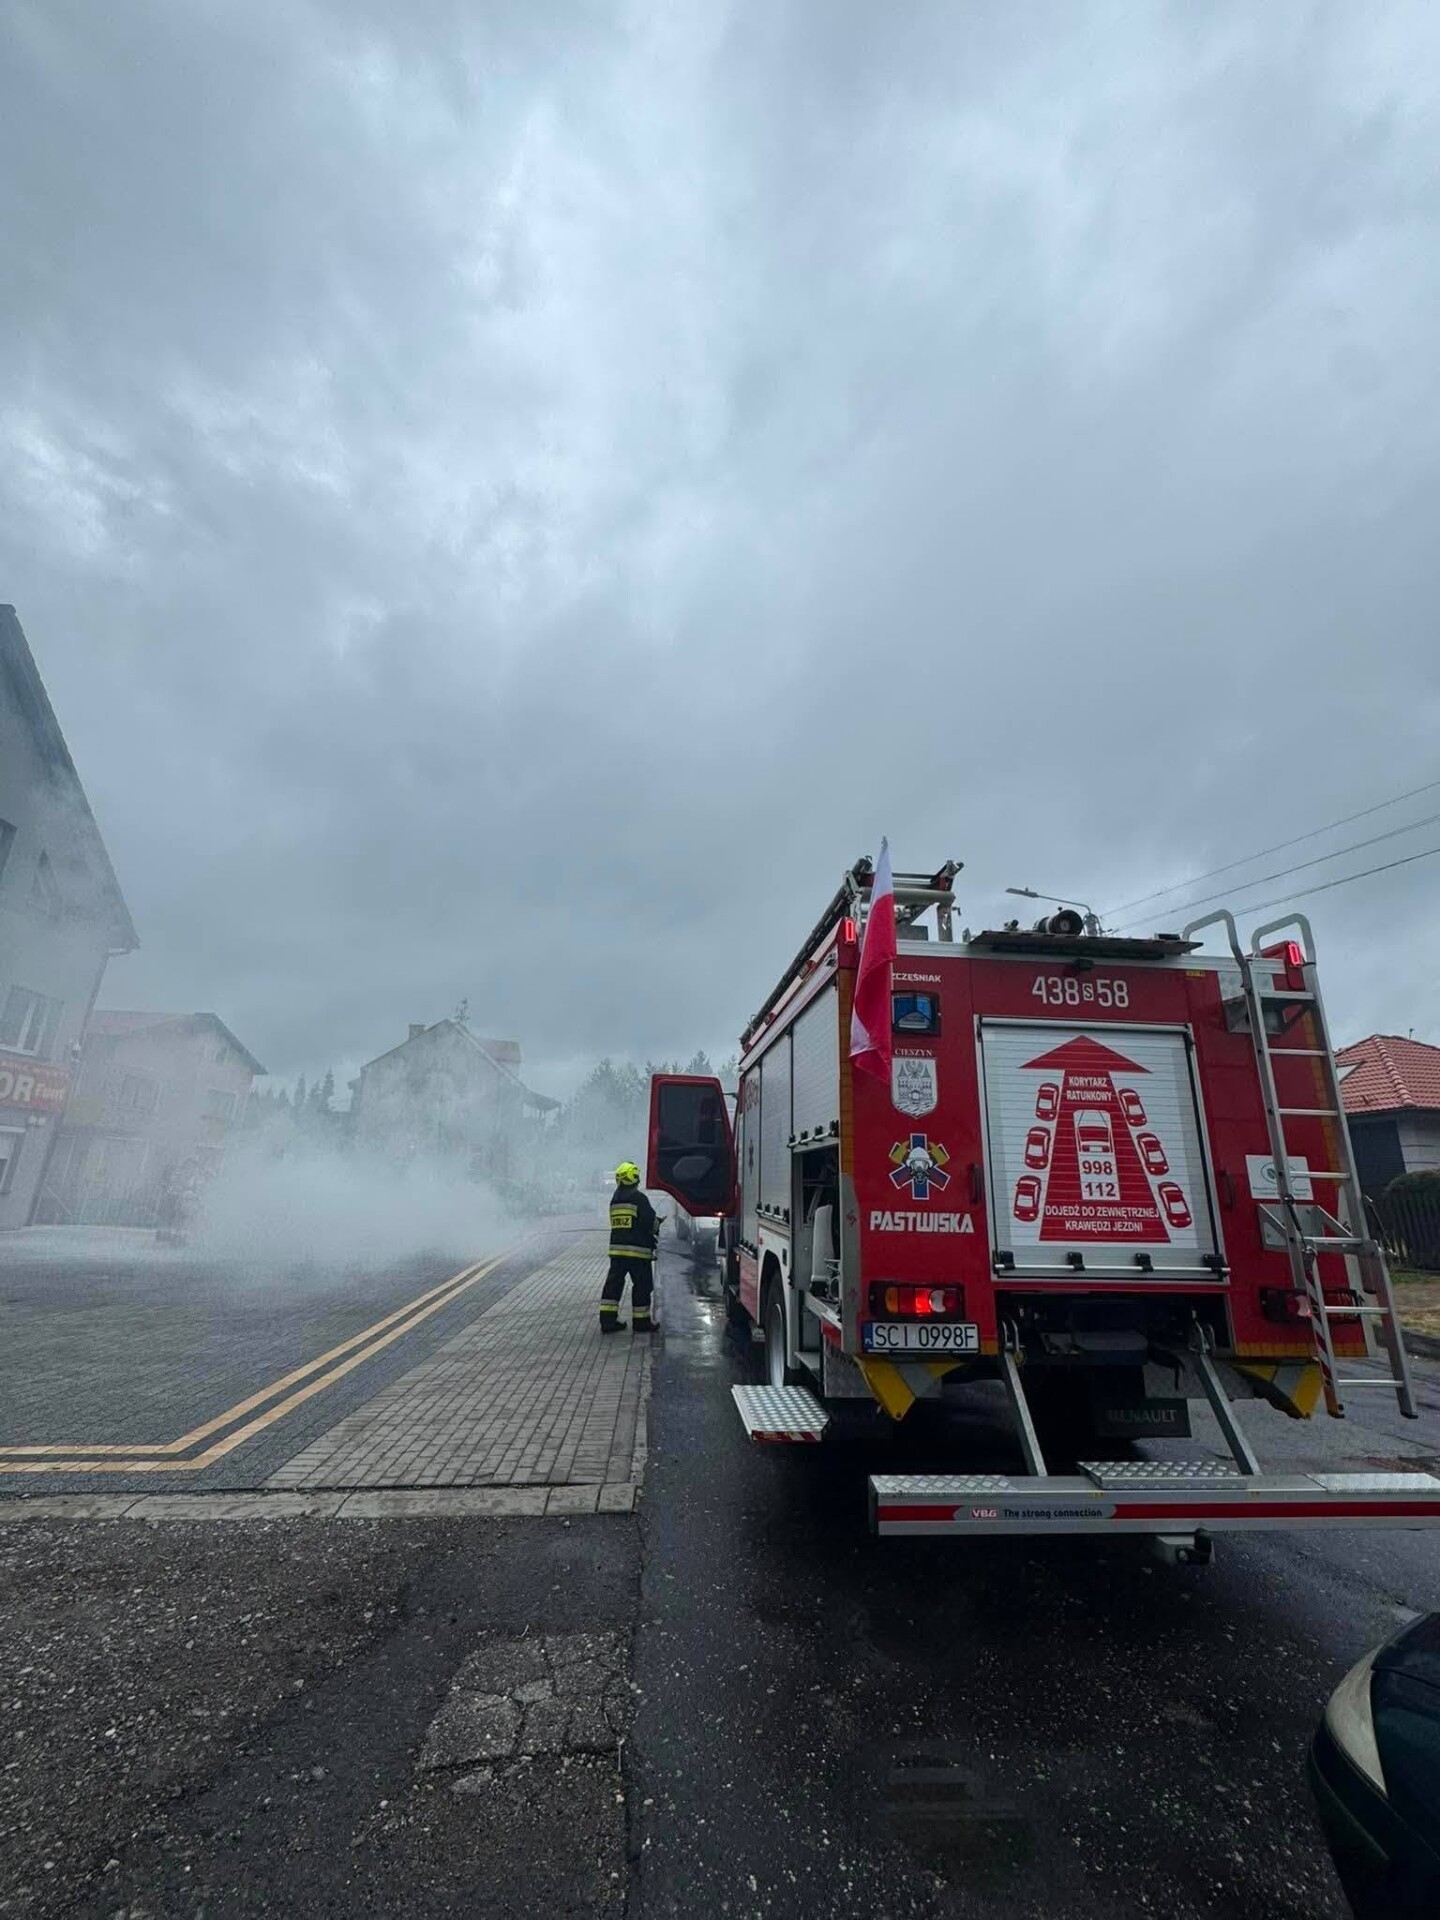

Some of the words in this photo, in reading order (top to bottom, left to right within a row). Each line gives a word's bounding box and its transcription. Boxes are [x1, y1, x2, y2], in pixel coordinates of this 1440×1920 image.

[891, 972, 942, 982] ZCZEŚNIAK
[894, 1047, 933, 1056] CIESZYN
[1069, 1076, 1107, 1088] KORYTARZ
[1066, 1090, 1112, 1101] RATUNKOWY
[1082, 1160, 1113, 1175] 998
[1085, 1182, 1116, 1197] 112
[1045, 1204, 1080, 1216] DOJEDŹ
[1082, 1206, 1095, 1216] DO
[1096, 1206, 1159, 1219] ZEWNĘTRZNEJ
[870, 1210, 975, 1233] PASTWISKA
[1065, 1220, 1111, 1233] KRAWĘDZI
[1112, 1221, 1143, 1232] JEZDNI
[875, 1325, 909, 1347] SCI
[918, 1326, 976, 1348] 0998F
[1004, 1508, 1020, 1518] The
[1021, 1509, 1051, 1519] strong
[1053, 1508, 1103, 1518] connection
